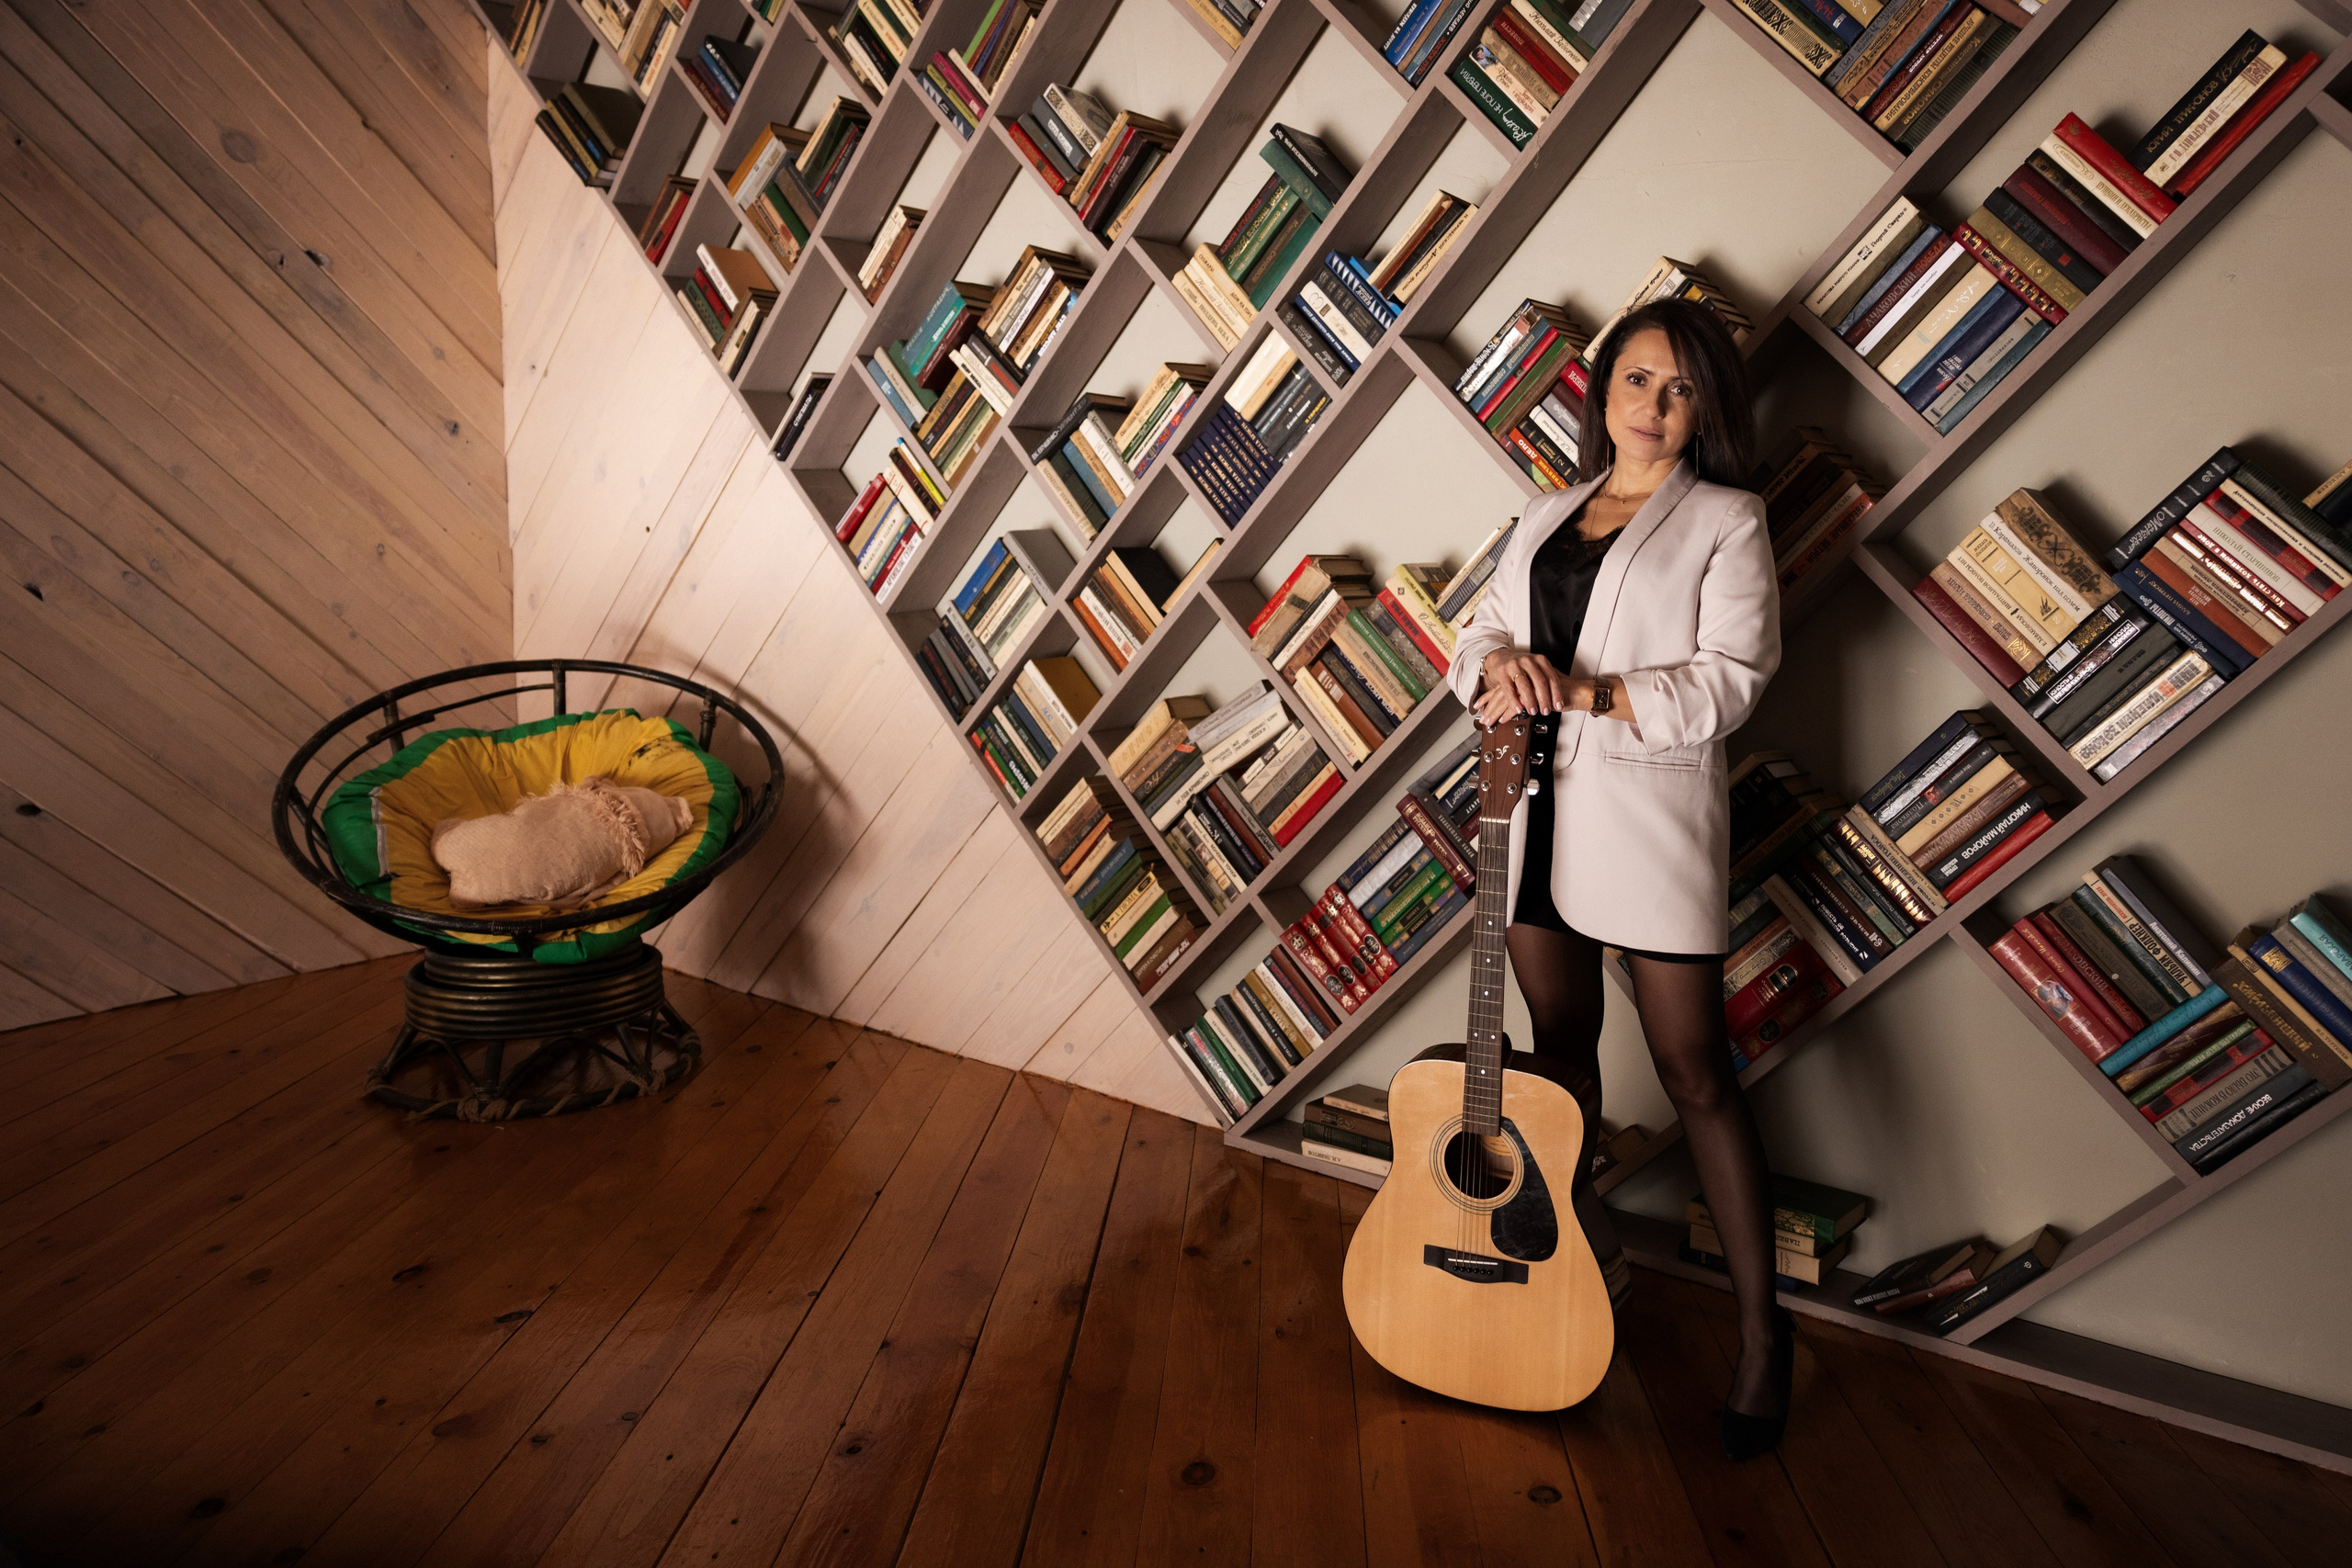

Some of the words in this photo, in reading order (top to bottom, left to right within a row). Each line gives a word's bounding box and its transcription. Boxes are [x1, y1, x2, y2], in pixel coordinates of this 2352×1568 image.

[1447, 6, 1467, 32] ЛЕБЕДЕВ
[1951, 17, 1977, 45] ЛУЧШИЕ
[1499, 20, 1524, 45] ПОВЕСТИ
[1527, 8, 1558, 39] Николай
[1552, 34, 1583, 64] Задорнов
[1928, 40, 1956, 70] РЕЦЕПТЫ
[1937, 35, 1981, 82] Константин
[1457, 67, 1484, 94] ПЕРЕЙТИ
[1478, 88, 1498, 107] ПОЛЕ
[1883, 67, 1934, 121] КОНСЕРВИРОВАНИЯ
[1899, 78, 1944, 125] СИМОНОВ
[1492, 102, 1504, 114] НЕ
[2144, 124, 2174, 153] ЮРИЙ
[2172, 77, 2219, 126] ТРИФОНОВ
[1267, 185, 1283, 207] ЮРИЙ
[2094, 180, 2119, 203] ПУШКИН
[2118, 199, 2152, 232] ДЕКАБРИСТЫ
[1870, 227, 1890, 248] Георгий
[1230, 291, 1240, 302] ДОМ
[1862, 270, 1917, 328] А.ЧАКОВСКИЙ
[1914, 239, 1946, 273] ПОБЕДА
[1354, 288, 1372, 307] АСЕЕВ
[1477, 367, 1510, 397] справочник
[791, 392, 814, 427] СТИГМАТЫ
[1231, 424, 1247, 441] АГАТА
[1243, 439, 1261, 458] КРИСТИ
[1239, 421, 1257, 440] КРИСТИ
[1219, 441, 1234, 457] АГАТА
[1231, 456, 1249, 475] КРИСТИ
[1226, 433, 1239, 449] АГАТА
[1237, 447, 1254, 467] КРИСТИ
[1253, 438, 1269, 455] АГАТА
[1515, 437, 1539, 459] ДЕЛО
[1210, 460, 1227, 479] КРИСТИ
[1216, 454, 1234, 473] КРИСТИ
[1196, 475, 1214, 493] КРИСТИ
[1204, 468, 1220, 487] КРИСТИ
[1224, 478, 1239, 495] АГАТА
[1231, 471, 1246, 488] АГАТА
[2315, 468, 2346, 495] АЛЕКСЕЕВ
[1211, 492, 1226, 509] АГАТА
[1217, 485, 1233, 502] АГАТА
[2196, 532, 2216, 549] доме
[881, 555, 909, 586] АРХИПЕЛАГ
[899, 540, 918, 559] ГУЛАГ
[1957, 555, 1967, 566] НЕТ
[2211, 525, 2244, 552] НИКОЛАЙ
[2239, 547, 2281, 583] СТАРШИНОВ
[2218, 550, 2253, 579] хозяином
[1965, 562, 1984, 583] ПОЛОСЫ
[2021, 552, 2055, 589] Жаворонок
[2051, 583, 2064, 597] над
[2061, 592, 2081, 614] полем
[2250, 576, 2272, 595] стать
[1982, 579, 2012, 612] НЕЙТРАЛЬНОЙ
[2189, 583, 2211, 603] ИСХОД
[2268, 592, 2285, 607] Как
[2148, 602, 2176, 626] ПИЛОТЫ
[2107, 622, 2132, 645] НИКОЛАЙ
[2110, 626, 2136, 649] ВОРОНОВ
[2049, 677, 2071, 697] ЮНОСТЬ
[1179, 789, 1190, 800] ЛЕВ
[1186, 770, 1211, 792] КРИВЕНКО
[1411, 815, 1430, 837] РУССКИЙ
[1415, 811, 1437, 839] ИСПАНСКО-
[1889, 800, 1924, 831] Полякова
[1900, 810, 1921, 829] Татьяна
[1994, 800, 2031, 834] НИКОЛАЙ
[1869, 834, 1892, 857] ГОЛОСА
[1960, 826, 1999, 863] МАЙОРОВ
[1887, 854, 1918, 886] ВЕСЕННИЕ
[1815, 906, 1841, 933] УГОЛОВНОМ
[1838, 931, 1860, 953] РОЗЫСКЕ
[1819, 903, 1838, 923] ПОВЕСТЬ
[1837, 921, 1845, 930] ОБ
[1849, 914, 1870, 937] ИЛЬЯС
[2128, 919, 2163, 958] ФОЛКНЕР
[2148, 919, 2177, 953] Анатолий
[2175, 947, 2200, 978] Калинин
[2158, 952, 2188, 985] УИЛЬЯМ
[1216, 1003, 1243, 1037] АНАТОЛИЙ
[1238, 1035, 1261, 1066] РЫБАКОВ
[2324, 1035, 2348, 1061] ТУРГЕНЕВ
[2223, 1075, 2248, 1097] БЫЛО
[2244, 1066, 2261, 1083] ЭТО
[2187, 1092, 2222, 1121] КОКАНДЕ
[2244, 1092, 2273, 1115] ВЕСКИЕ
[2187, 1108, 2247, 1153] ДОКАЗАТЕЛЬСТВА
